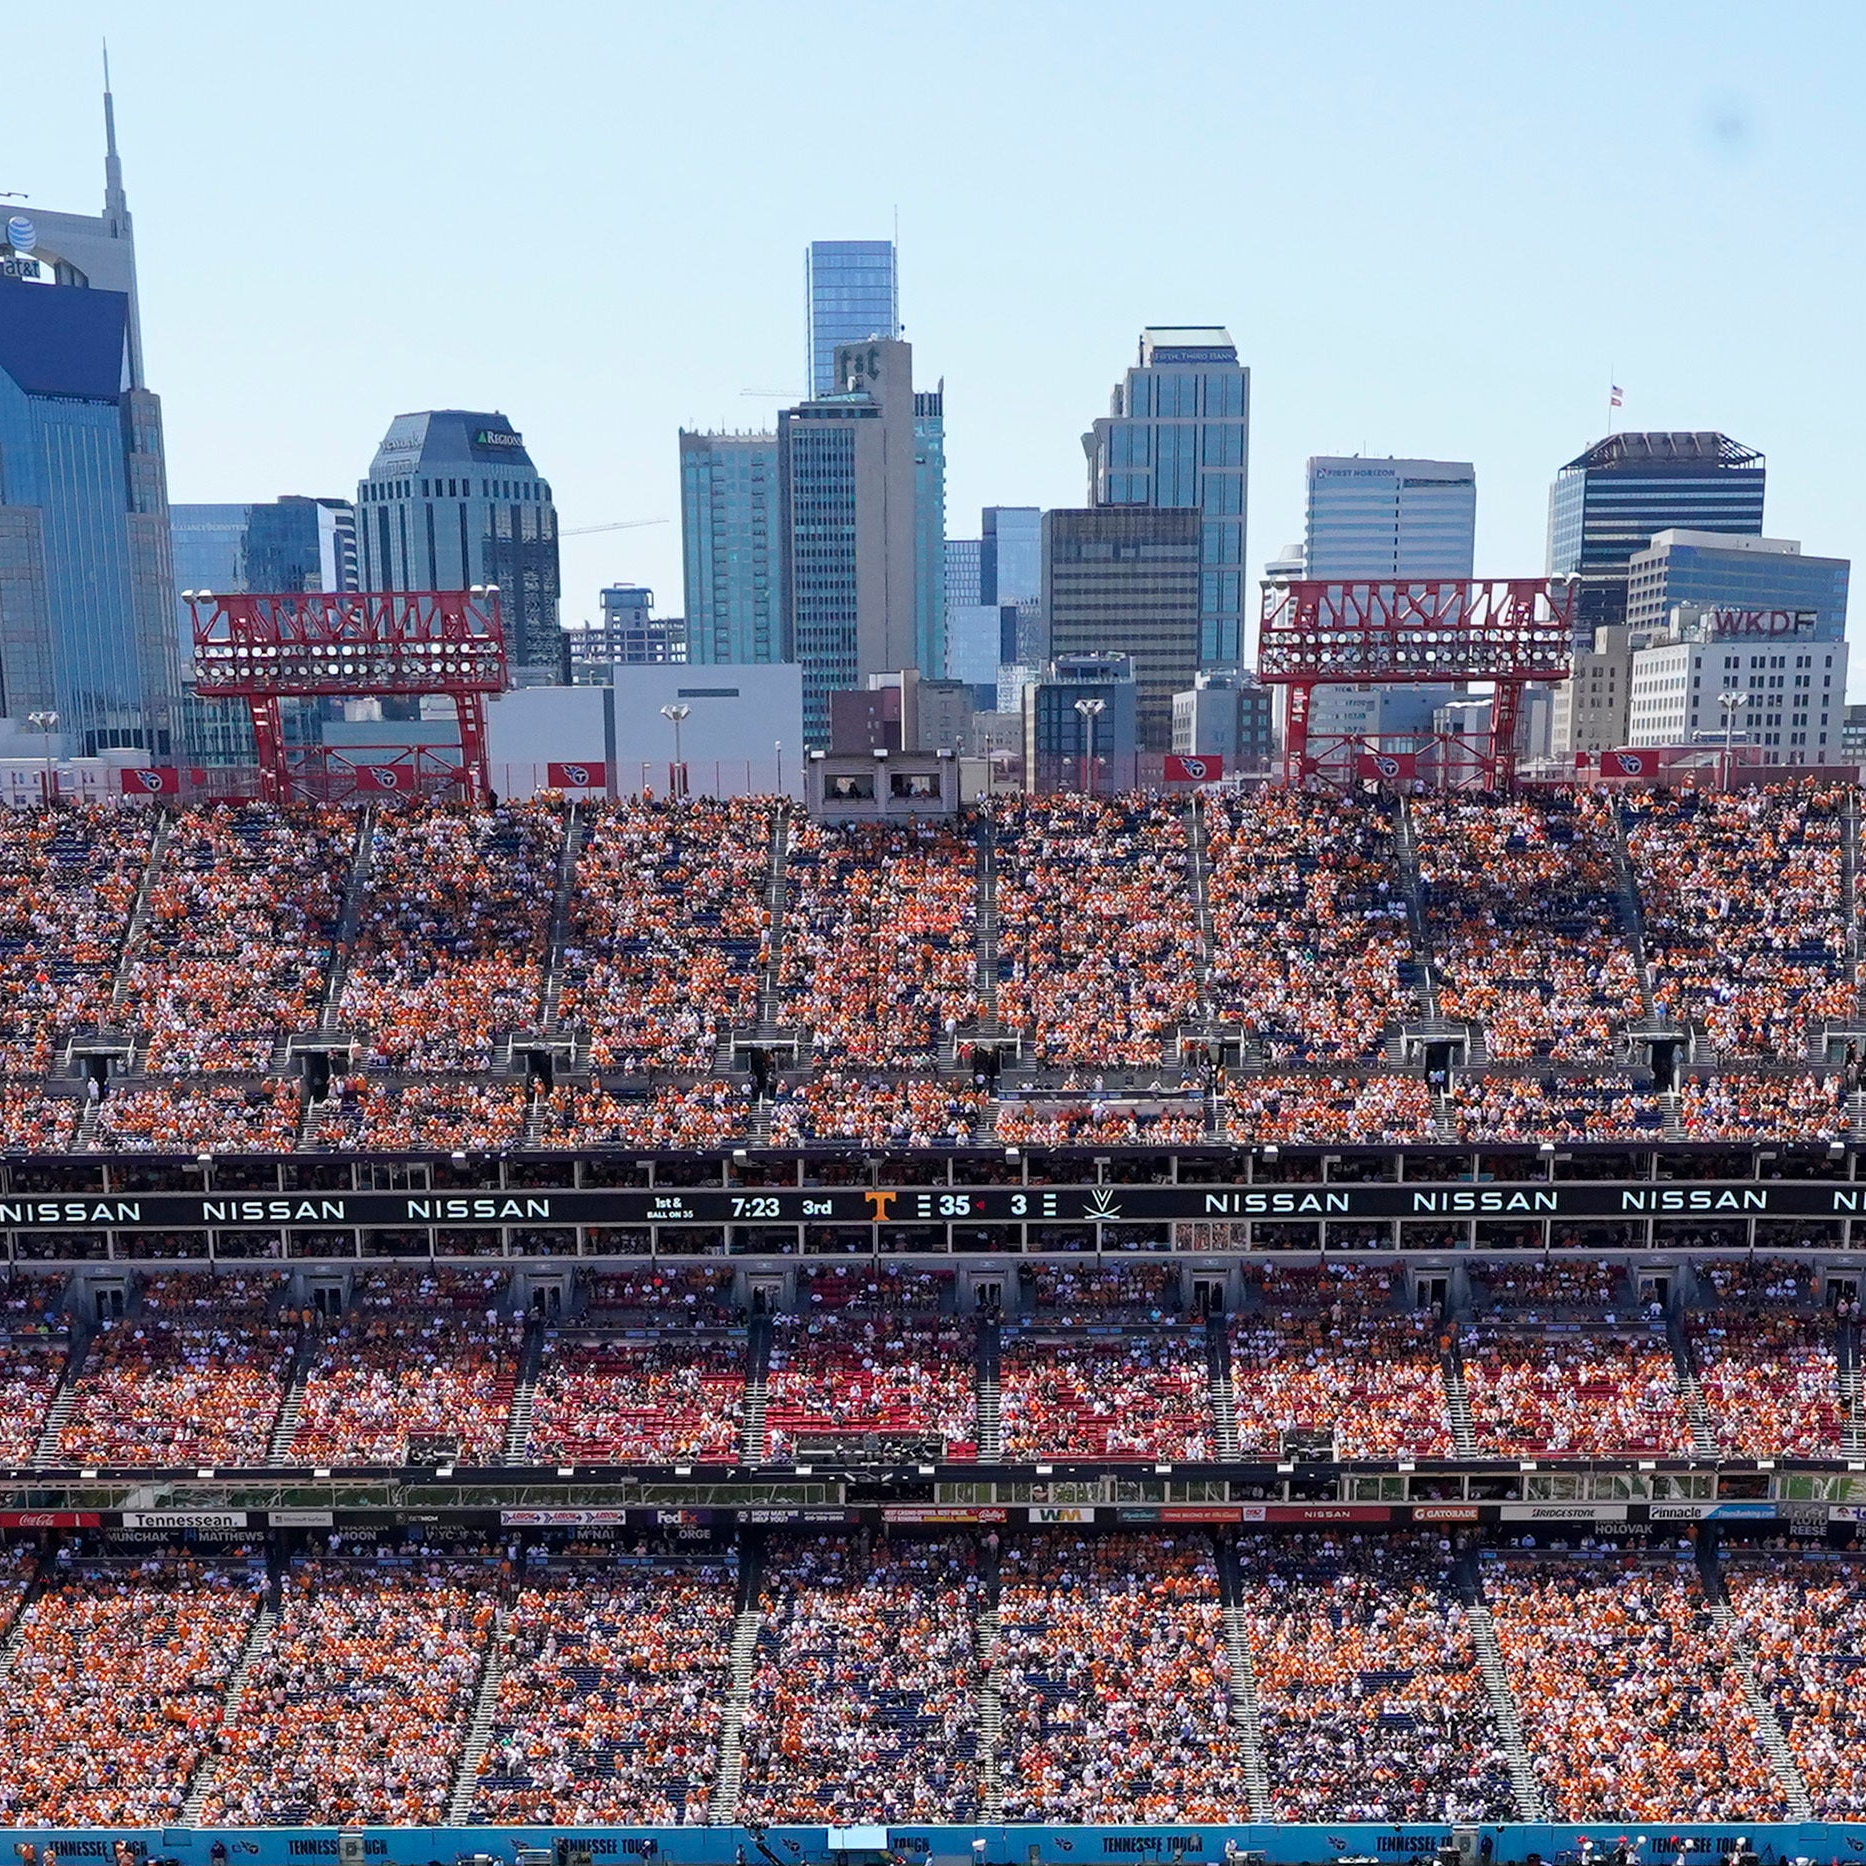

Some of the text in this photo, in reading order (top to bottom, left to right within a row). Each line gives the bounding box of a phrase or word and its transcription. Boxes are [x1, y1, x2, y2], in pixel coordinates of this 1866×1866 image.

[5, 258, 40, 278] at&t
[1714, 608, 1818, 635] WKDF
[732, 1197, 780, 1217] 7:23
[802, 1198, 832, 1215] 3rd
[939, 1195, 971, 1215] 35
[1011, 1195, 1028, 1215] 3
[1205, 1193, 1349, 1213] NISSAN
[1413, 1191, 1558, 1211] NISSAN
[1622, 1190, 1767, 1210] NISSAN
[203, 1200, 345, 1220] NISSAN
[407, 1199, 550, 1219] NISSAN
[657, 1510, 698, 1523] FedEx
[1304, 1510, 1350, 1518] NISSAN
[1427, 1508, 1478, 1519] GATORADE
[1531, 1508, 1596, 1518] BRIDGESTONE
[1651, 1506, 1702, 1519] Pinnacle
[198, 1530, 265, 1542] MATTHEWS
[1595, 1524, 1653, 1535] HOLOVAK
[1790, 1525, 1827, 1535] REESE
[288, 1840, 340, 1856] TENNESS
[1101, 1836, 1163, 1853] TENNESSEE
